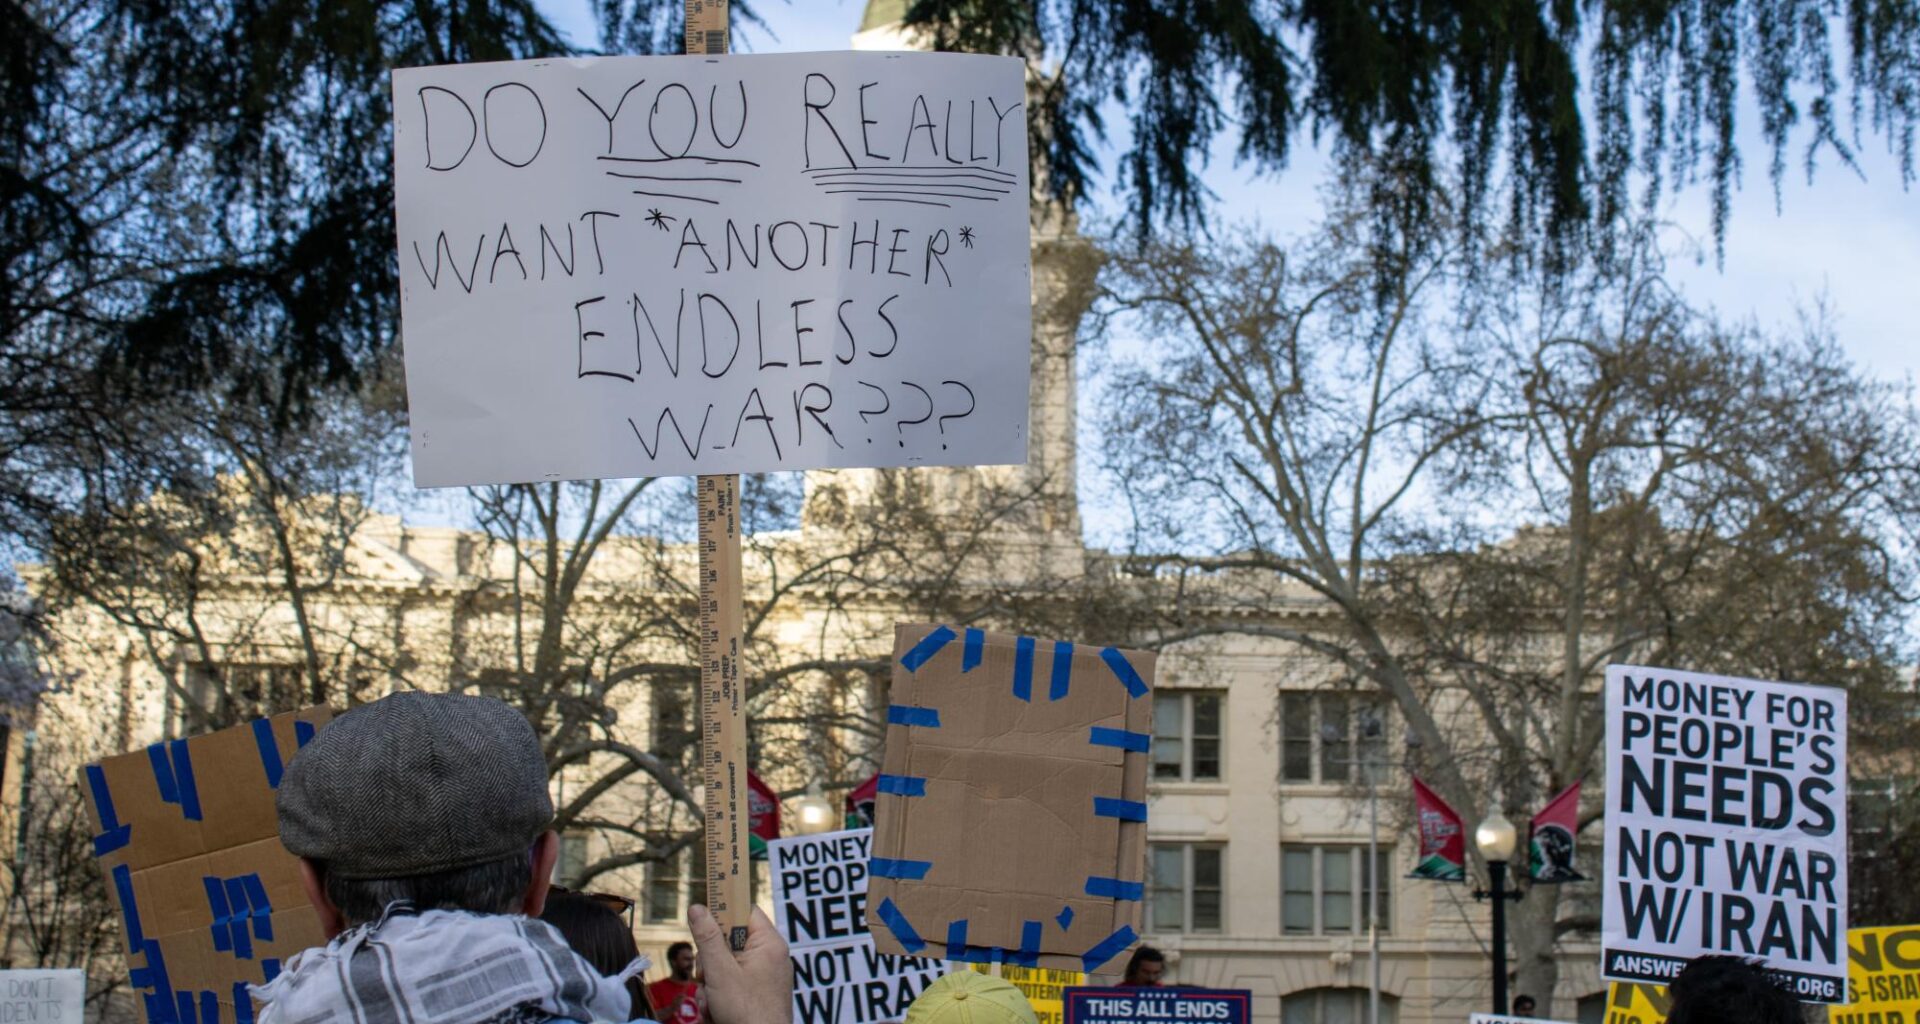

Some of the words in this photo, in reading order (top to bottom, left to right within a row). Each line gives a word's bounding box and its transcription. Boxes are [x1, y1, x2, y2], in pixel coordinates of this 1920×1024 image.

[418, 82, 547, 171] DO
[577, 79, 748, 159] YOU
[803, 73, 1022, 169] REALLY
[413, 211, 620, 294] WANT
[575, 288, 900, 382] ENDLESS
[717, 489, 725, 516] PAINT
[722, 654, 730, 679] PREP
[1623, 676, 1755, 720] MONEY
[1766, 693, 1836, 732] FOR
[1622, 711, 1836, 775] PEOPLE'S
[1620, 754, 1836, 837] NEEDS
[731, 845, 740, 861] you
[778, 835, 871, 869] MONEY
[1619, 826, 1714, 886] NOT
[1725, 839, 1837, 904] WAR
[781, 861, 870, 900] PEOP
[785, 893, 869, 943] NEE
[790, 947, 854, 990] NOT
[1613, 955, 1687, 978] ANSWE
[1848, 973, 1920, 1003] S-ISRA
[1086, 999, 1133, 1017] THIS
[1136, 1000, 1172, 1018] ALL
[1175, 1001, 1229, 1019] ENDS
